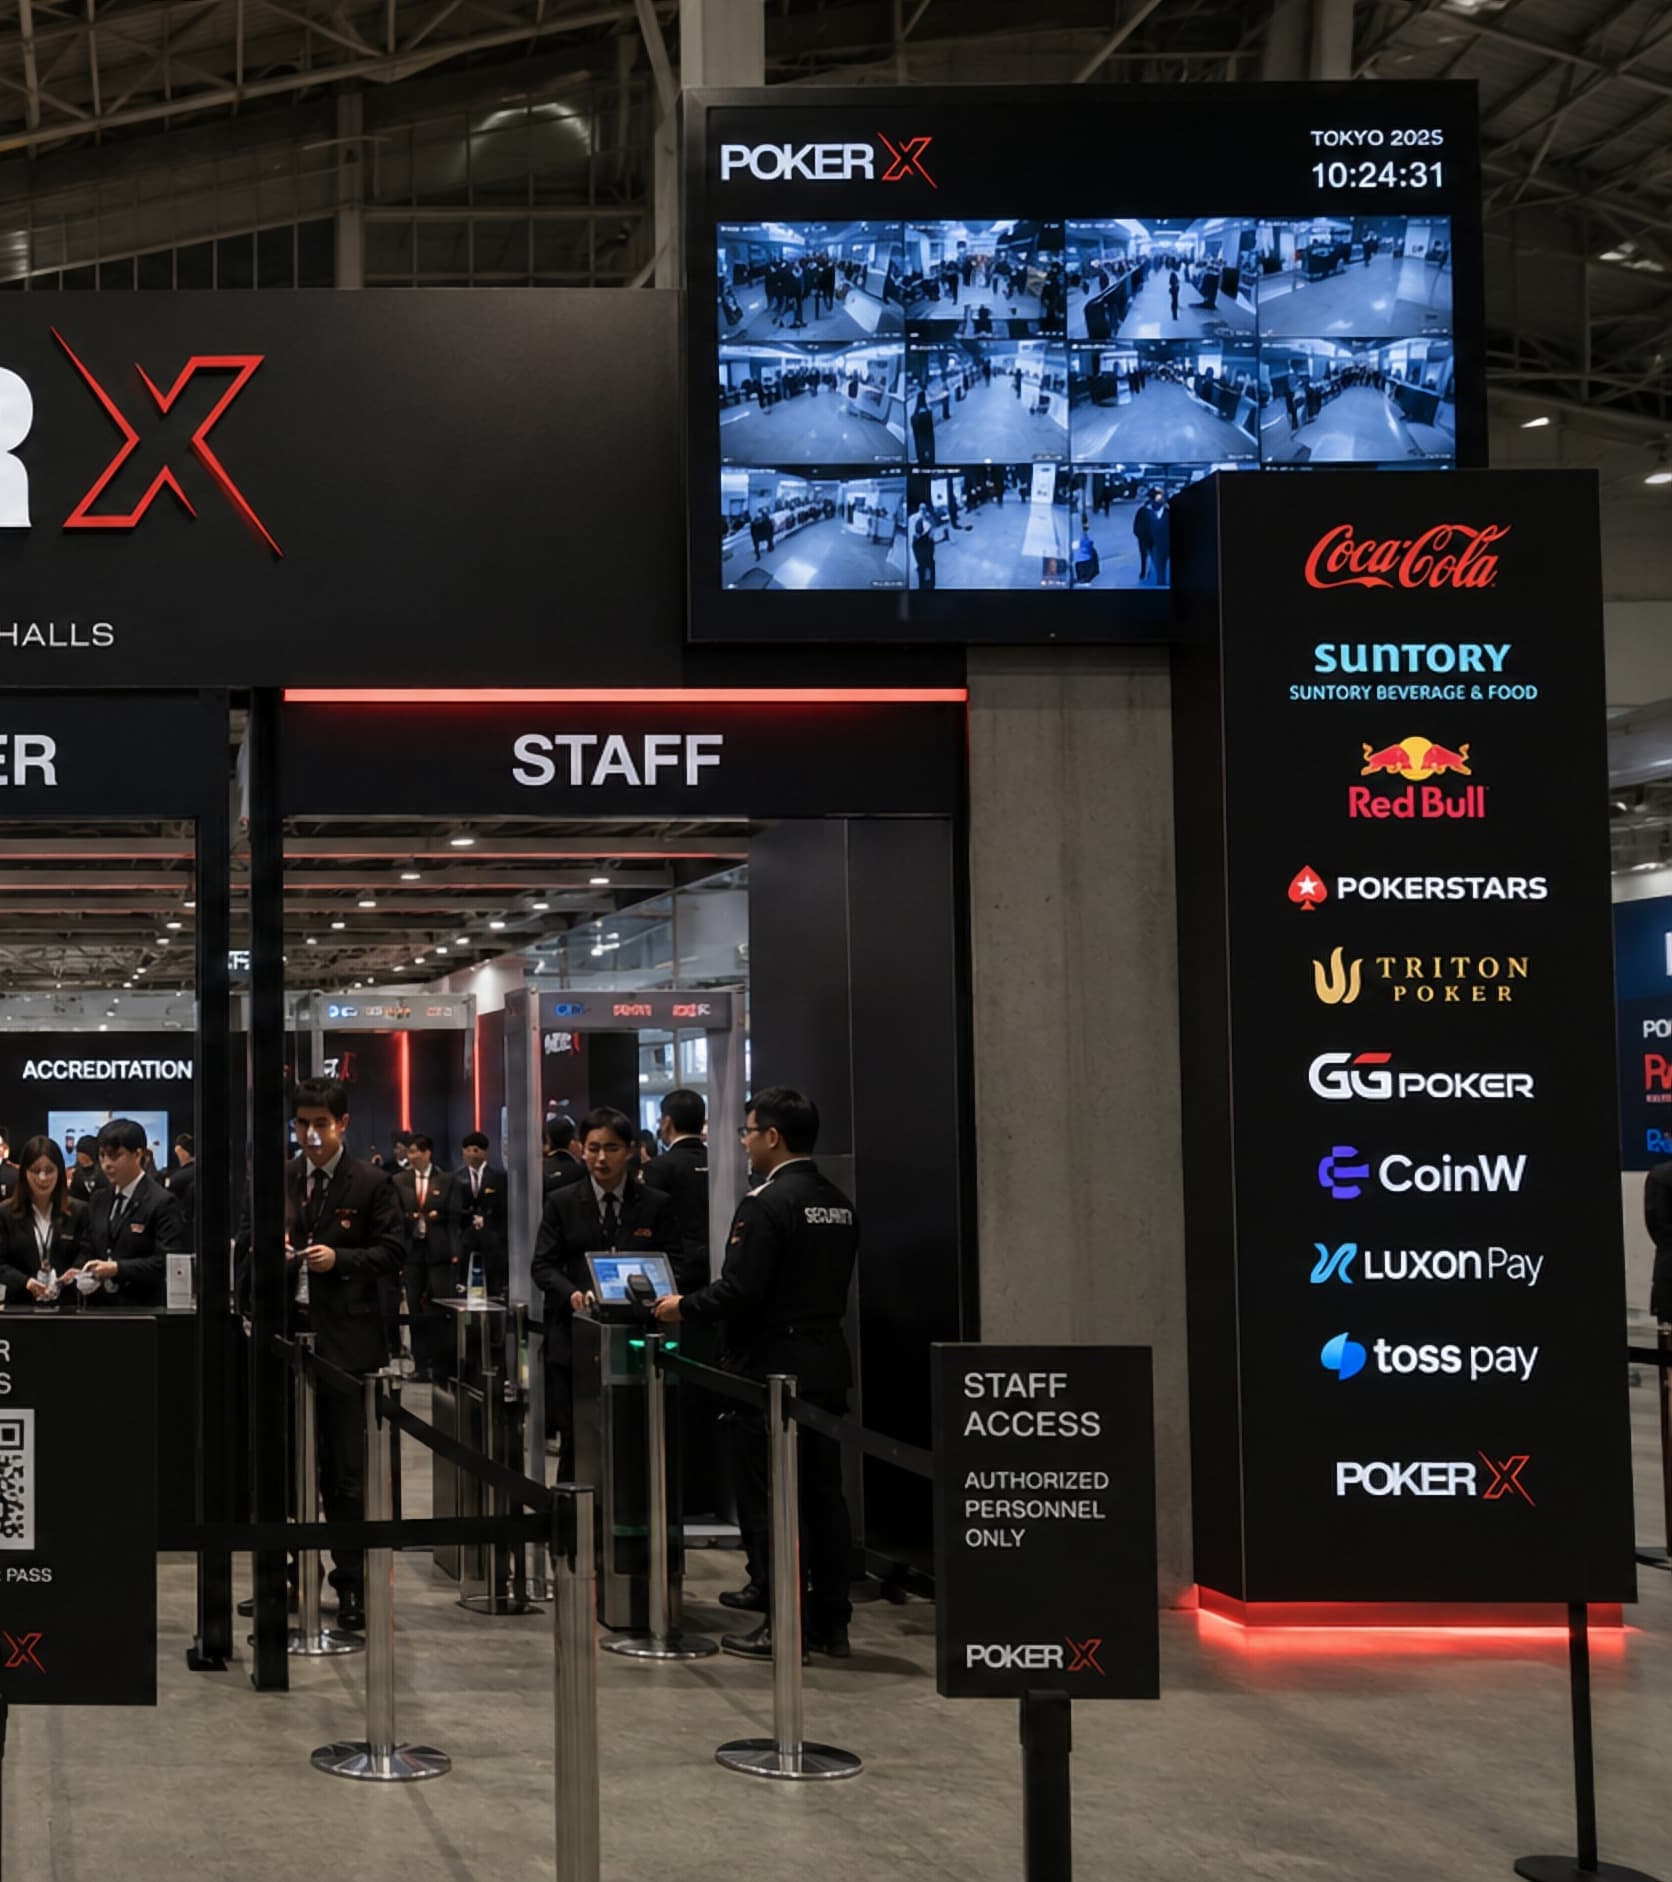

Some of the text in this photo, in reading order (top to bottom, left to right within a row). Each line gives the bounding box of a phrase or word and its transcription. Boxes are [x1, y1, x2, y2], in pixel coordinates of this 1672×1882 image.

[1310, 128, 1444, 147] TOKYO 2025
[720, 143, 875, 181] POKER
[1312, 160, 1442, 189] 10:24:31
[1304, 523, 1511, 589] Coca-Cola
[1289, 684, 1538, 701] SUNTORY BEVERAGE & FOOD
[512, 733, 724, 786] STAFF
[1348, 785, 1485, 819] Red Bull
[1337, 876, 1548, 900] POKERSTARS
[1375, 956, 1528, 979] TRITON
[1393, 985, 1512, 1002] POKER
[22, 1059, 193, 1080] ACCREDITATION
[1378, 1153, 1527, 1192] CoinW
[1487, 1246, 1544, 1287] Pay
[1372, 1338, 1539, 1381] toss pay
[964, 1372, 1068, 1399] STAFF
[963, 1410, 1101, 1437] ACCESS
[964, 1471, 1110, 1490] AUTHORIZED
[1336, 1461, 1477, 1496] POKER
[965, 1499, 1106, 1519] PERSONNEL
[965, 1528, 1026, 1548] ONLY
[6, 1567, 53, 1583] PASS
[966, 1644, 1064, 1669] POKER
